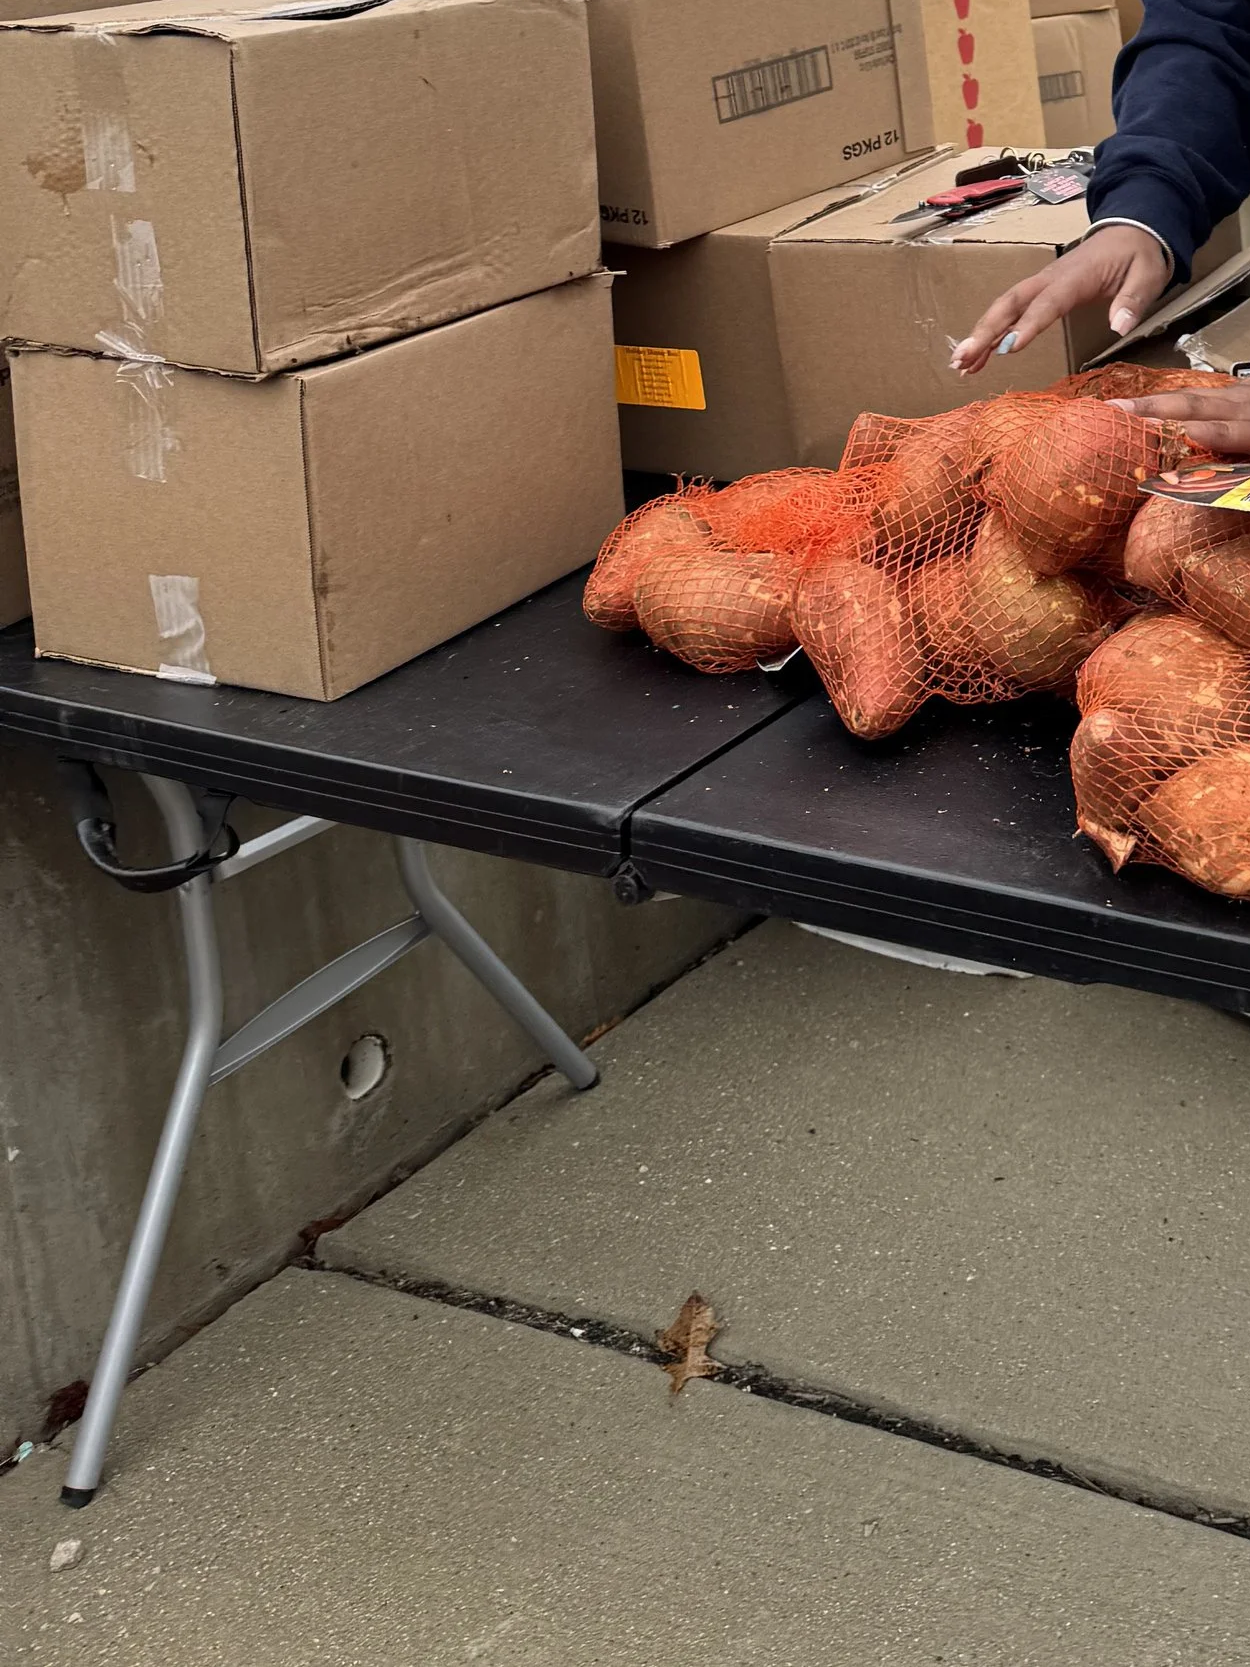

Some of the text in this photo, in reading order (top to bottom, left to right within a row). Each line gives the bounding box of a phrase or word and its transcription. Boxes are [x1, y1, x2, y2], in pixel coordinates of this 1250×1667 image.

[842, 129, 901, 161] 12 PKGS
[631, 209, 649, 226] 12
